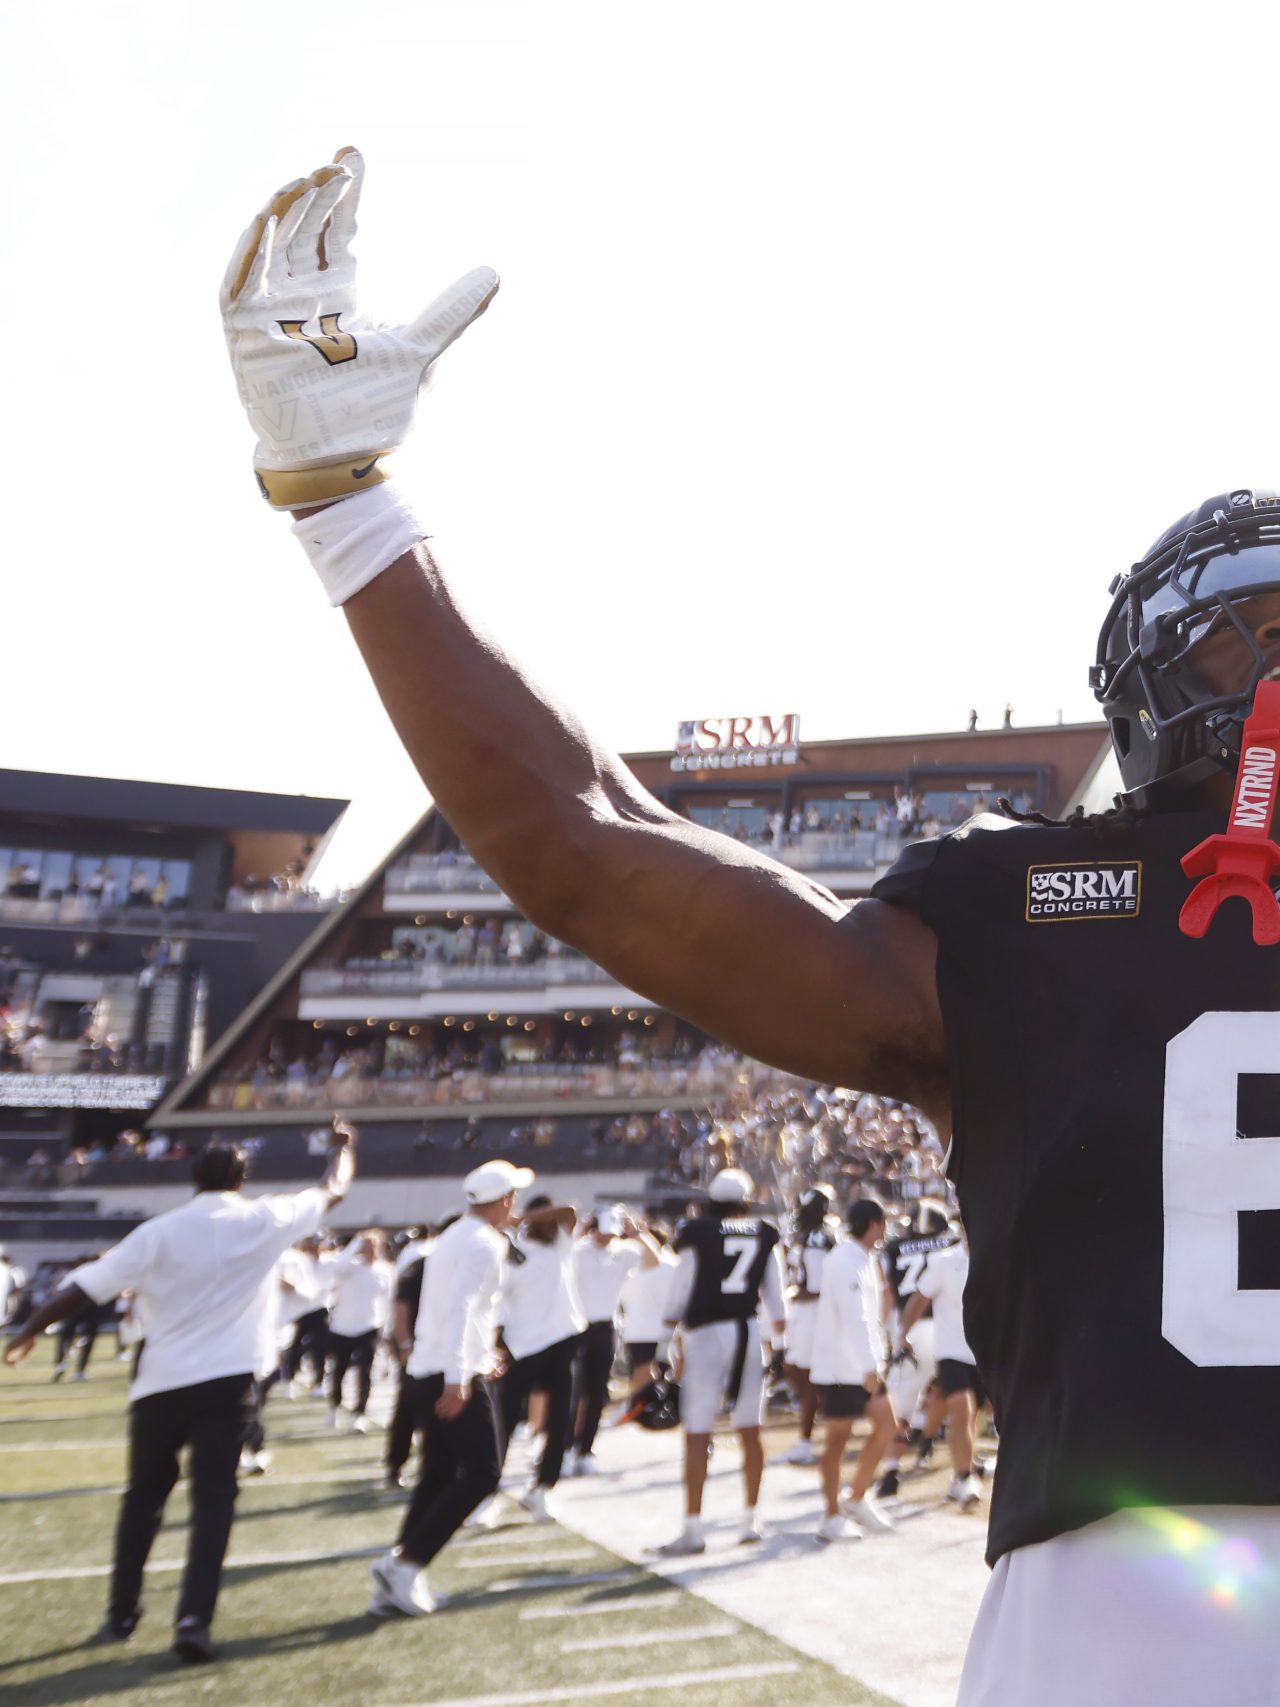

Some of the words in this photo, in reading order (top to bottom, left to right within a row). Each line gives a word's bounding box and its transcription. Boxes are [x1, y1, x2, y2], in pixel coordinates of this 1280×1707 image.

[693, 714, 800, 752] SRM
[1233, 746, 1277, 828] NXTRND
[1048, 870, 1137, 901] SRM
[1030, 900, 1136, 914] CONCRETE
[721, 1237, 759, 1294] 7
